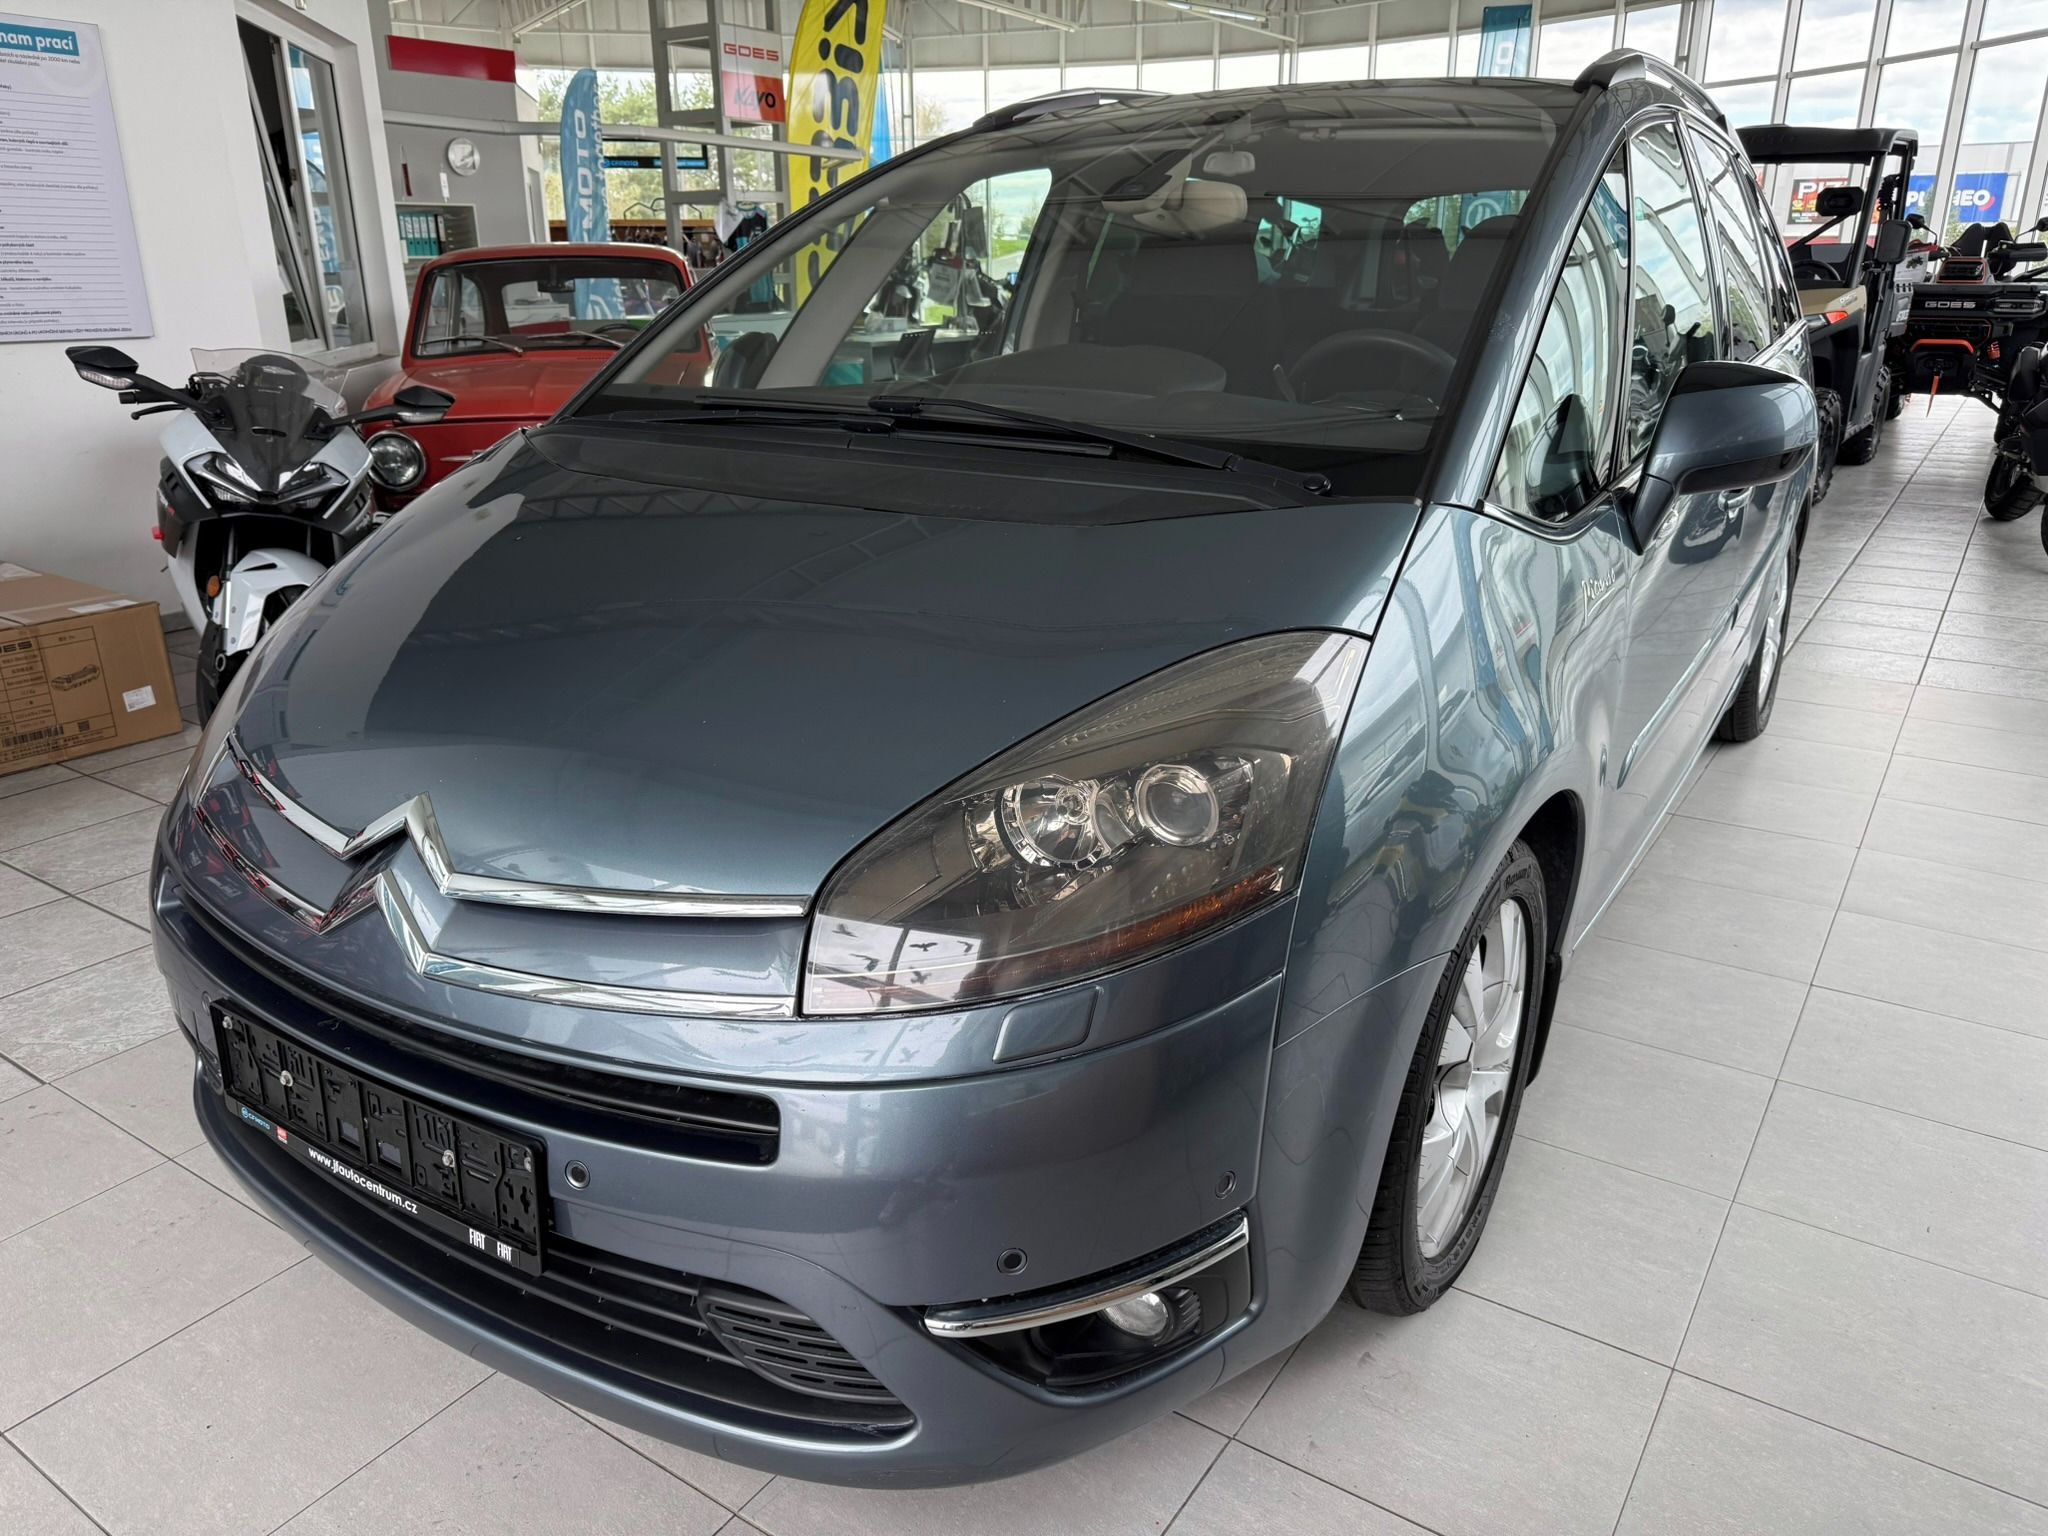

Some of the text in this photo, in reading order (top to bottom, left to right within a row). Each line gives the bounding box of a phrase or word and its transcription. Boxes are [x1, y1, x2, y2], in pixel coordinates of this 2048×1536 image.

[35, 36, 73, 51] prací
[723, 43, 779, 62] GOES
[573, 109, 593, 241] MOTO
[308, 1147, 418, 1215] www.jfautocentrum.cz
[468, 1227, 486, 1251] FIAT
[496, 1241, 512, 1262] FIAT
